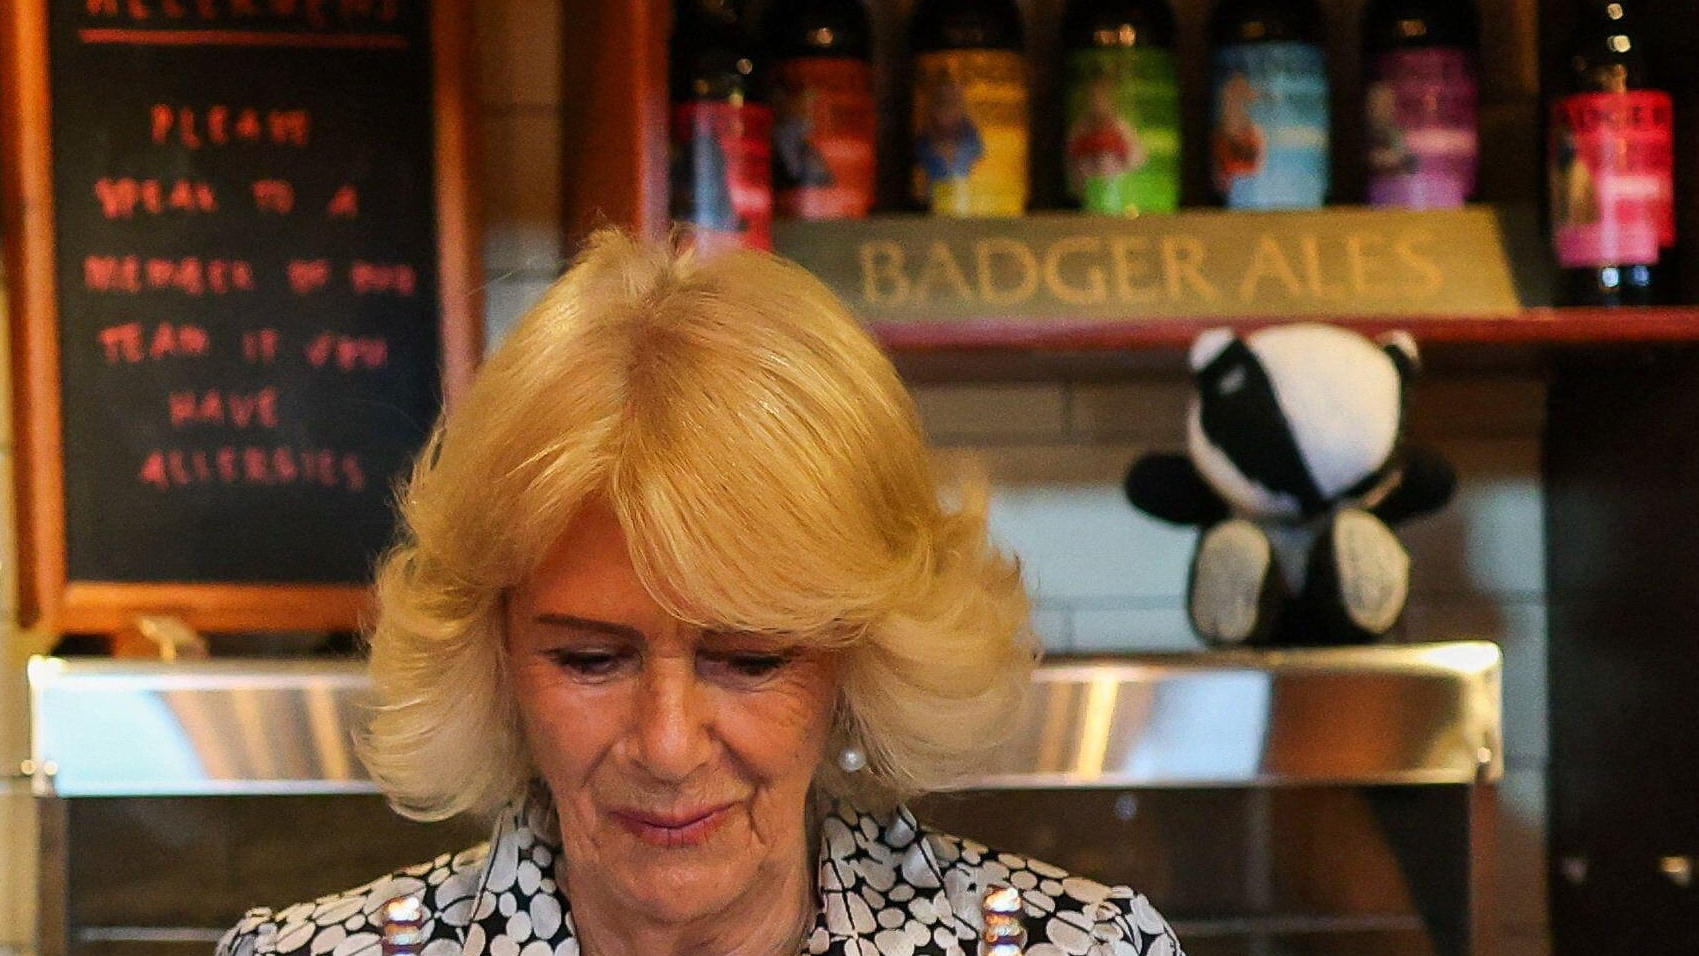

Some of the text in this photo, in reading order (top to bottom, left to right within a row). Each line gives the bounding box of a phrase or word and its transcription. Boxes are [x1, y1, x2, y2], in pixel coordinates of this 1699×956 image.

[328, 186, 358, 216] A
[858, 232, 1444, 304] BADGER ALES
